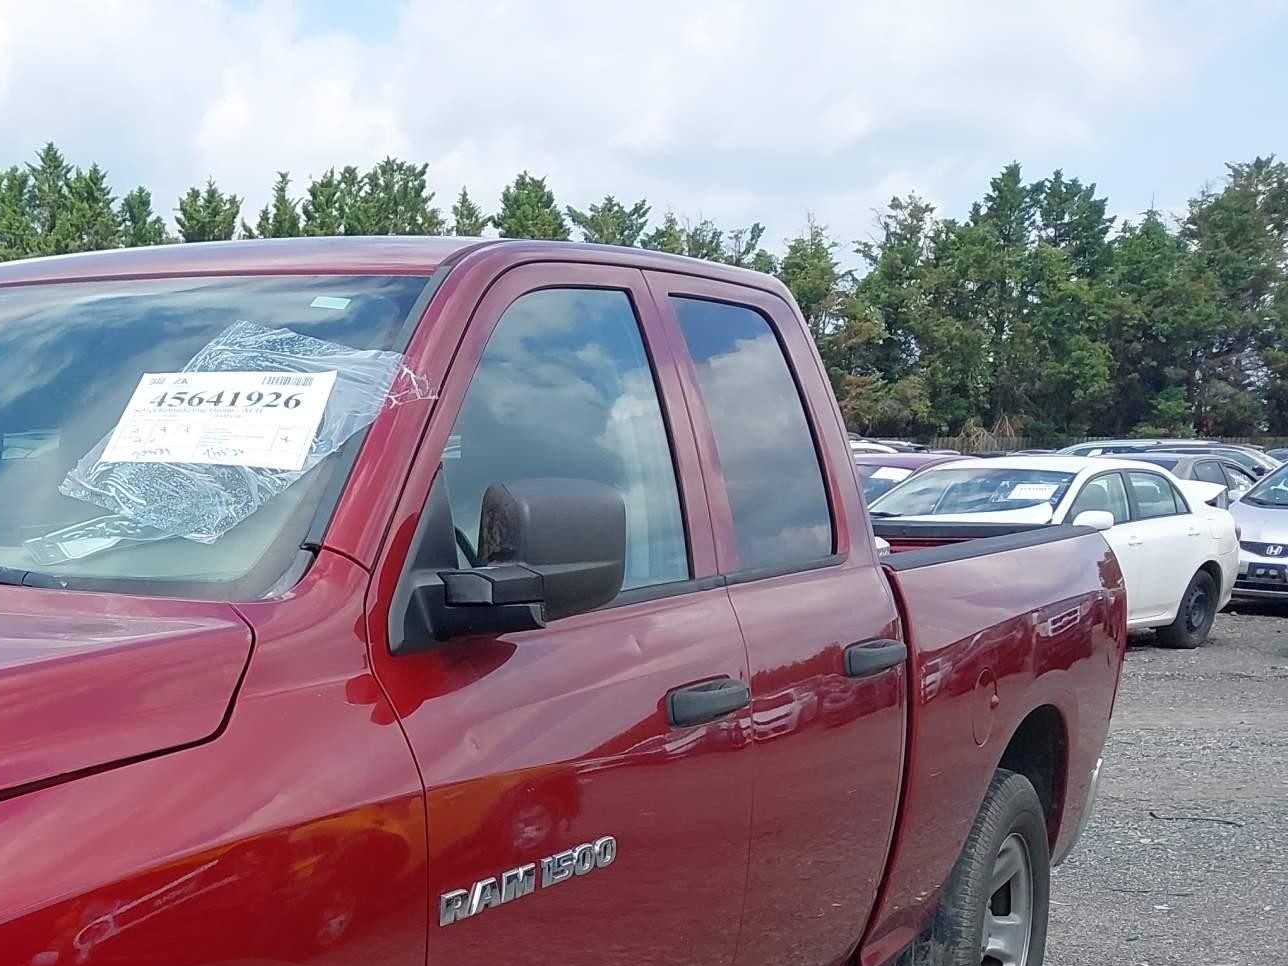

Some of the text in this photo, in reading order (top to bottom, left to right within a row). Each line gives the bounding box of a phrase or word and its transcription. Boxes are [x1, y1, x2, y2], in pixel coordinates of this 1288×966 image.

[149, 390, 304, 409] 45641926
[439, 835, 617, 927] RAM 1500
